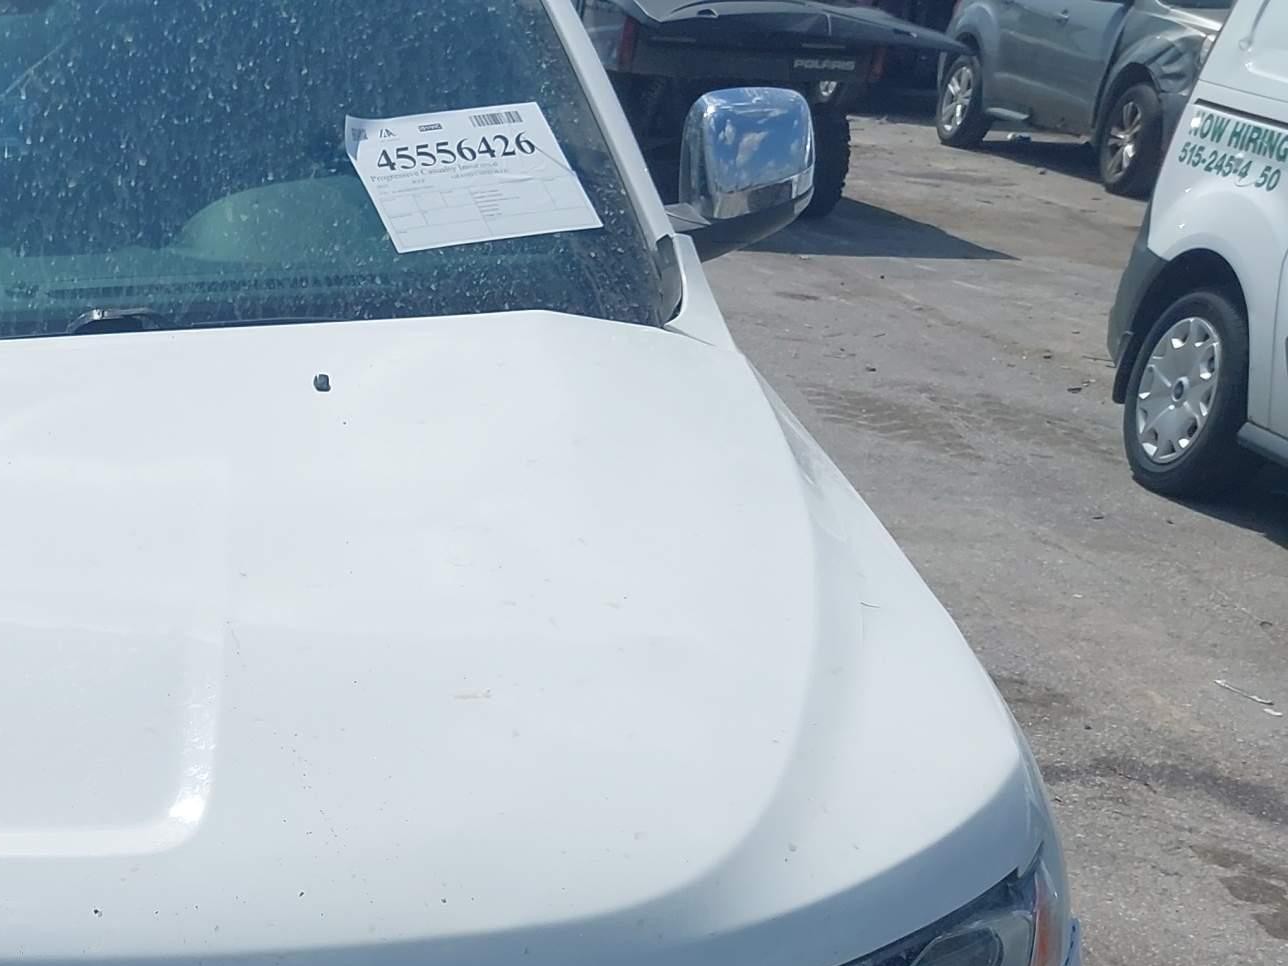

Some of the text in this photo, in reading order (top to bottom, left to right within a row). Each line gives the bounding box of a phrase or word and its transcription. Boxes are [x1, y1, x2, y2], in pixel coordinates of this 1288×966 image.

[793, 59, 855, 71] POLARIS
[377, 132, 536, 171] 45556426
[1227, 122, 1288, 162] HIRING
